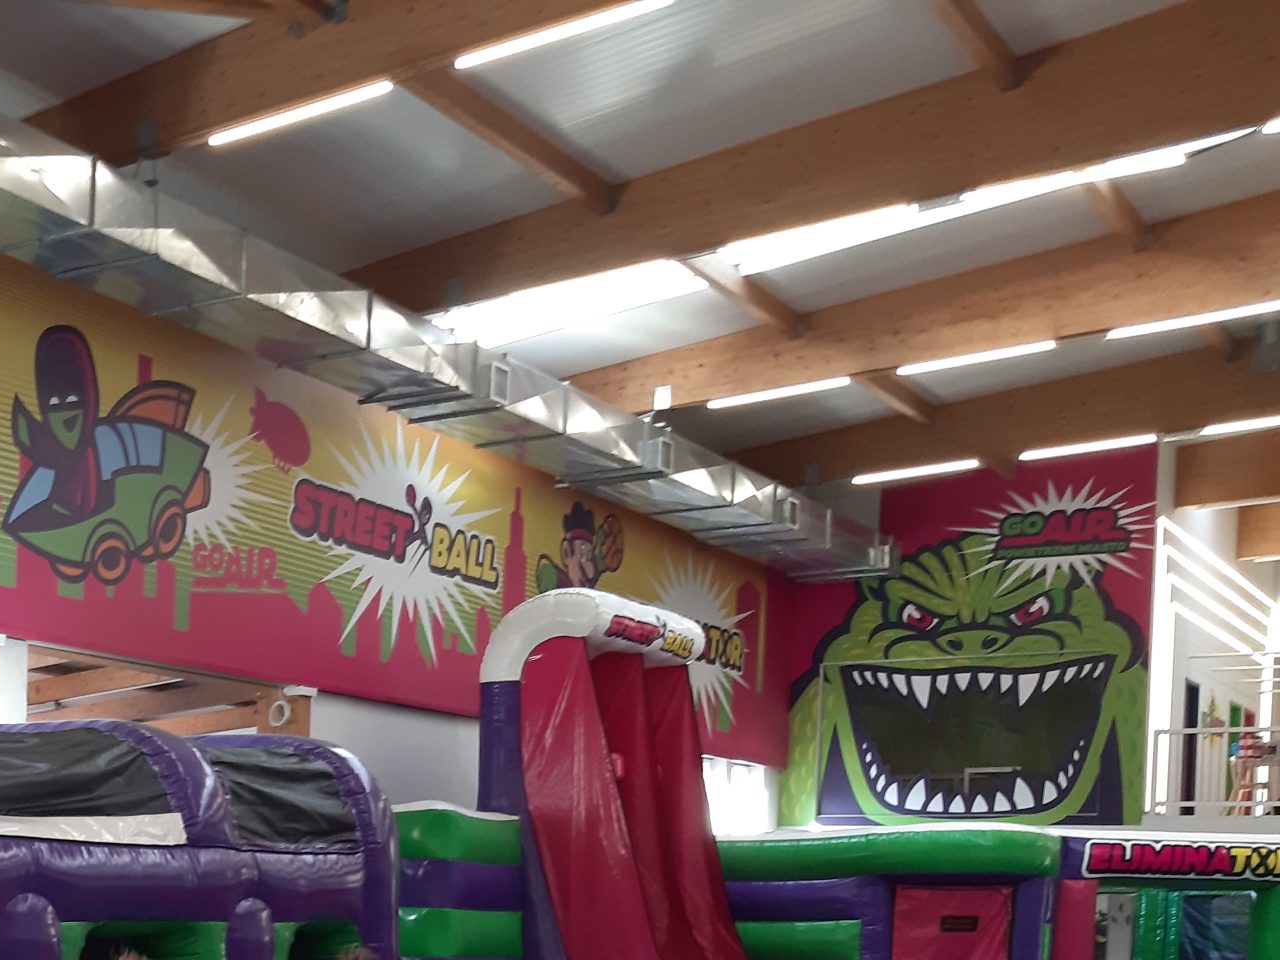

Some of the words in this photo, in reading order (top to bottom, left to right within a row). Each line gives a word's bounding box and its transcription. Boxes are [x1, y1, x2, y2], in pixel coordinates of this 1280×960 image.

[291, 480, 414, 562] STREET
[430, 523, 498, 589] BALL
[662, 631, 695, 659] BALL
[1088, 843, 1280, 876] ELIMINATO
